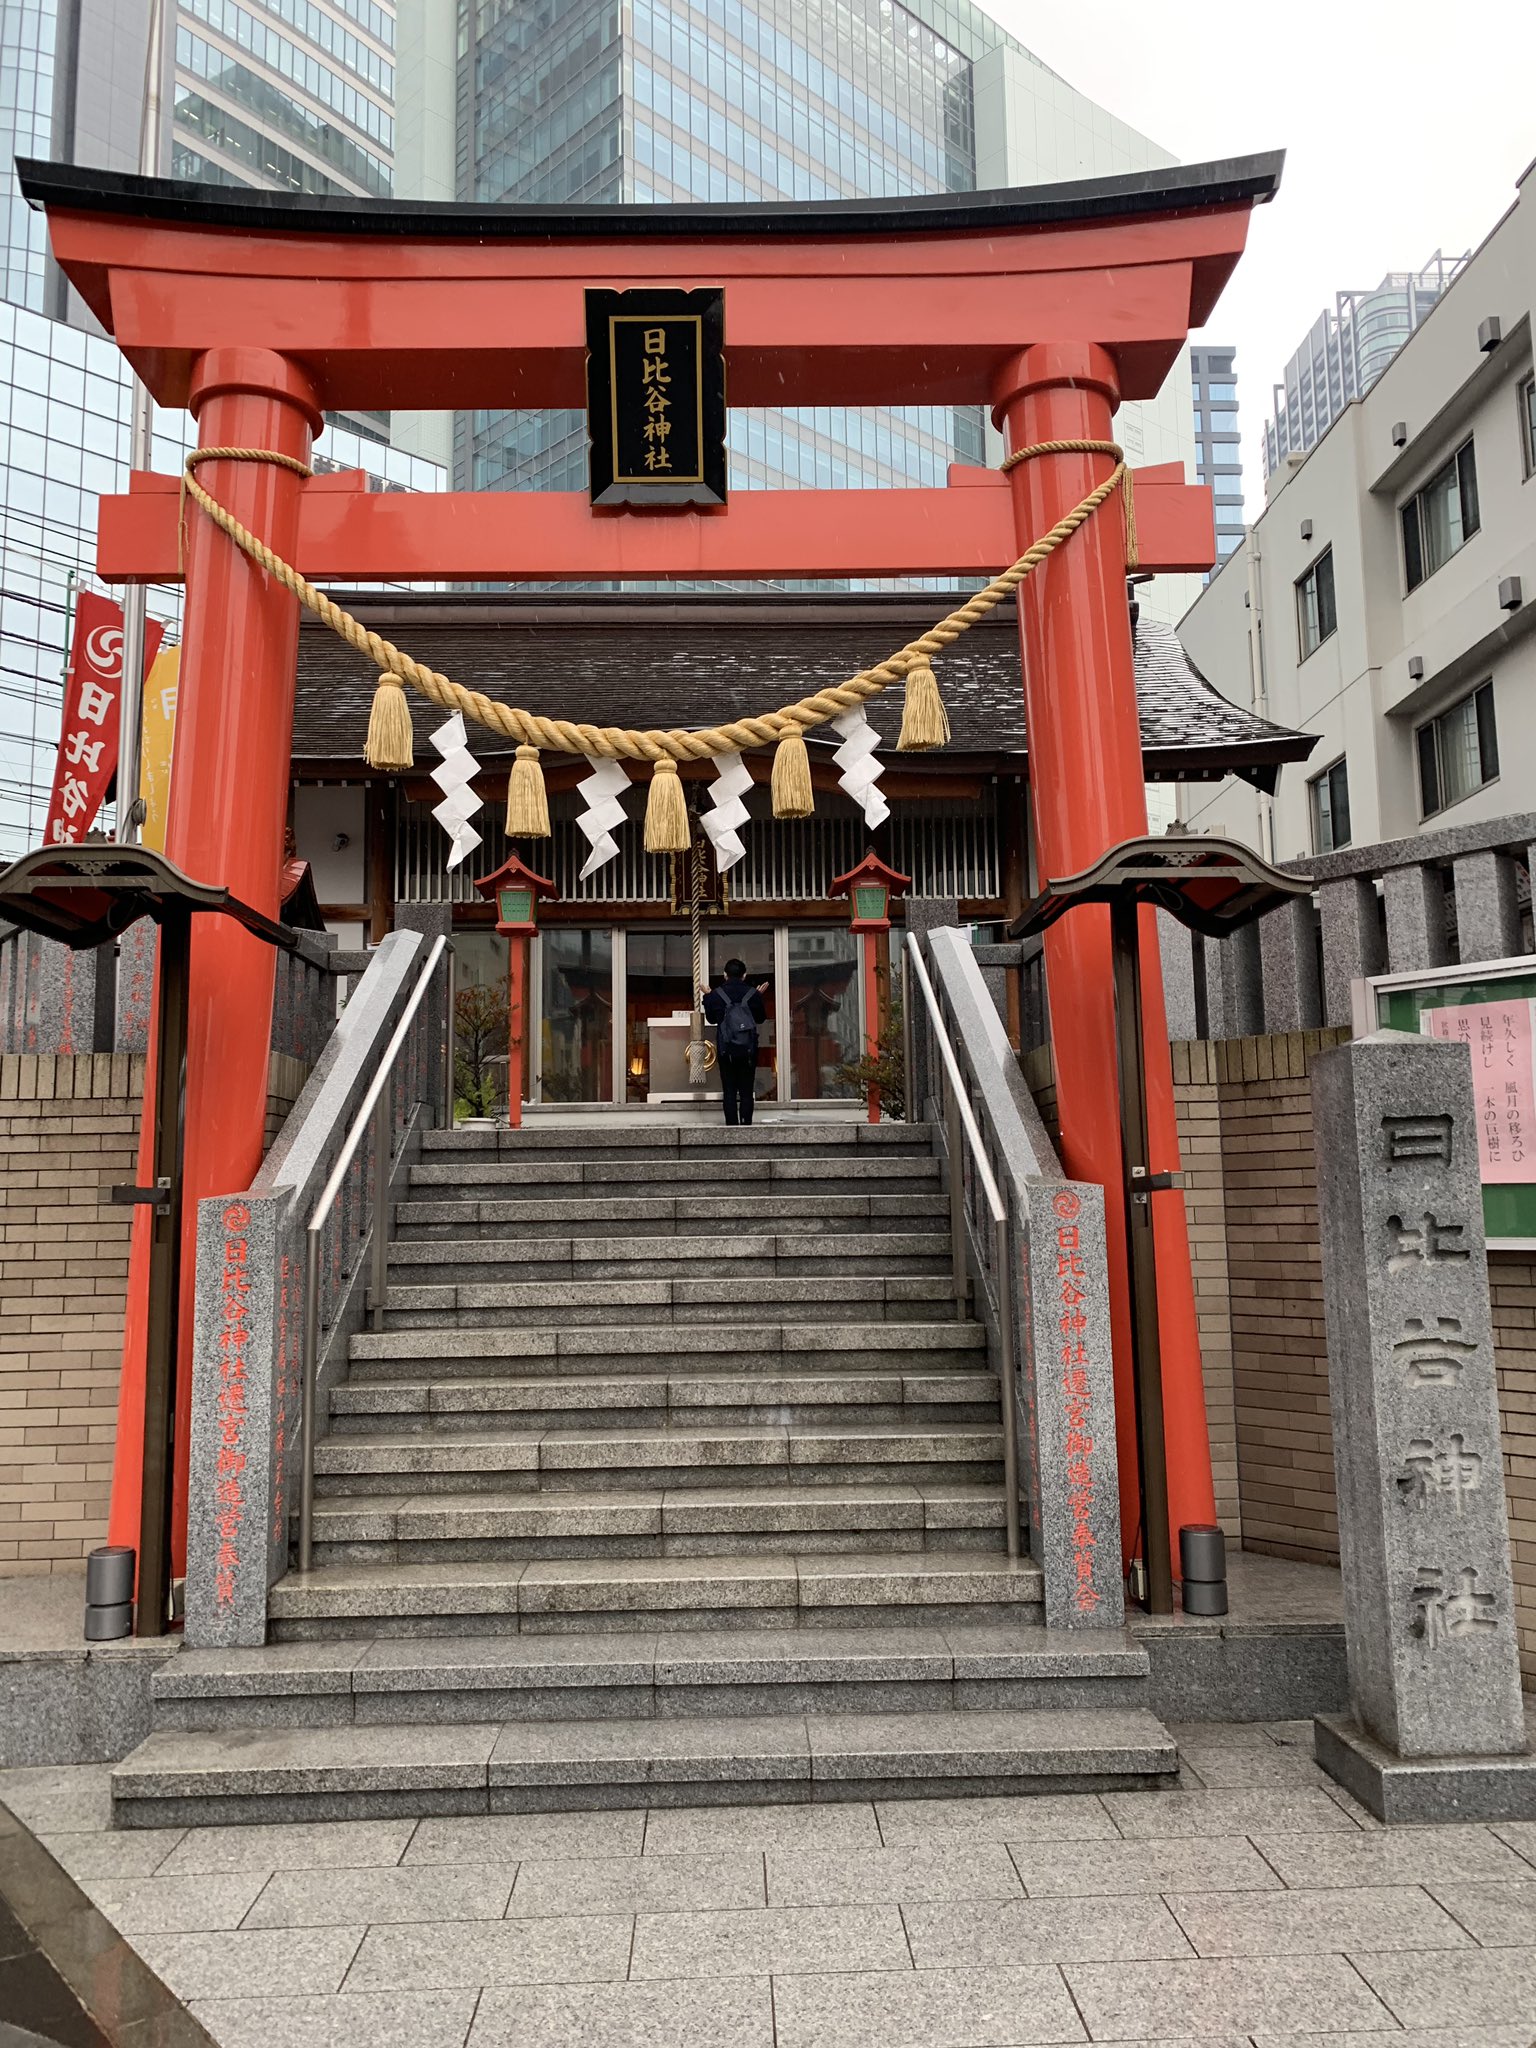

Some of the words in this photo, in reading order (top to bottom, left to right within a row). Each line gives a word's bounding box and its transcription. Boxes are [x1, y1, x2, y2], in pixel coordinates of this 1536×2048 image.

[642, 328, 673, 471] 日比谷神社
[1480, 1016, 1494, 1068] 見続けし
[1504, 1081, 1525, 1163] 風月の移ろひ
[1381, 1114, 1498, 1650] 日比谷神社
